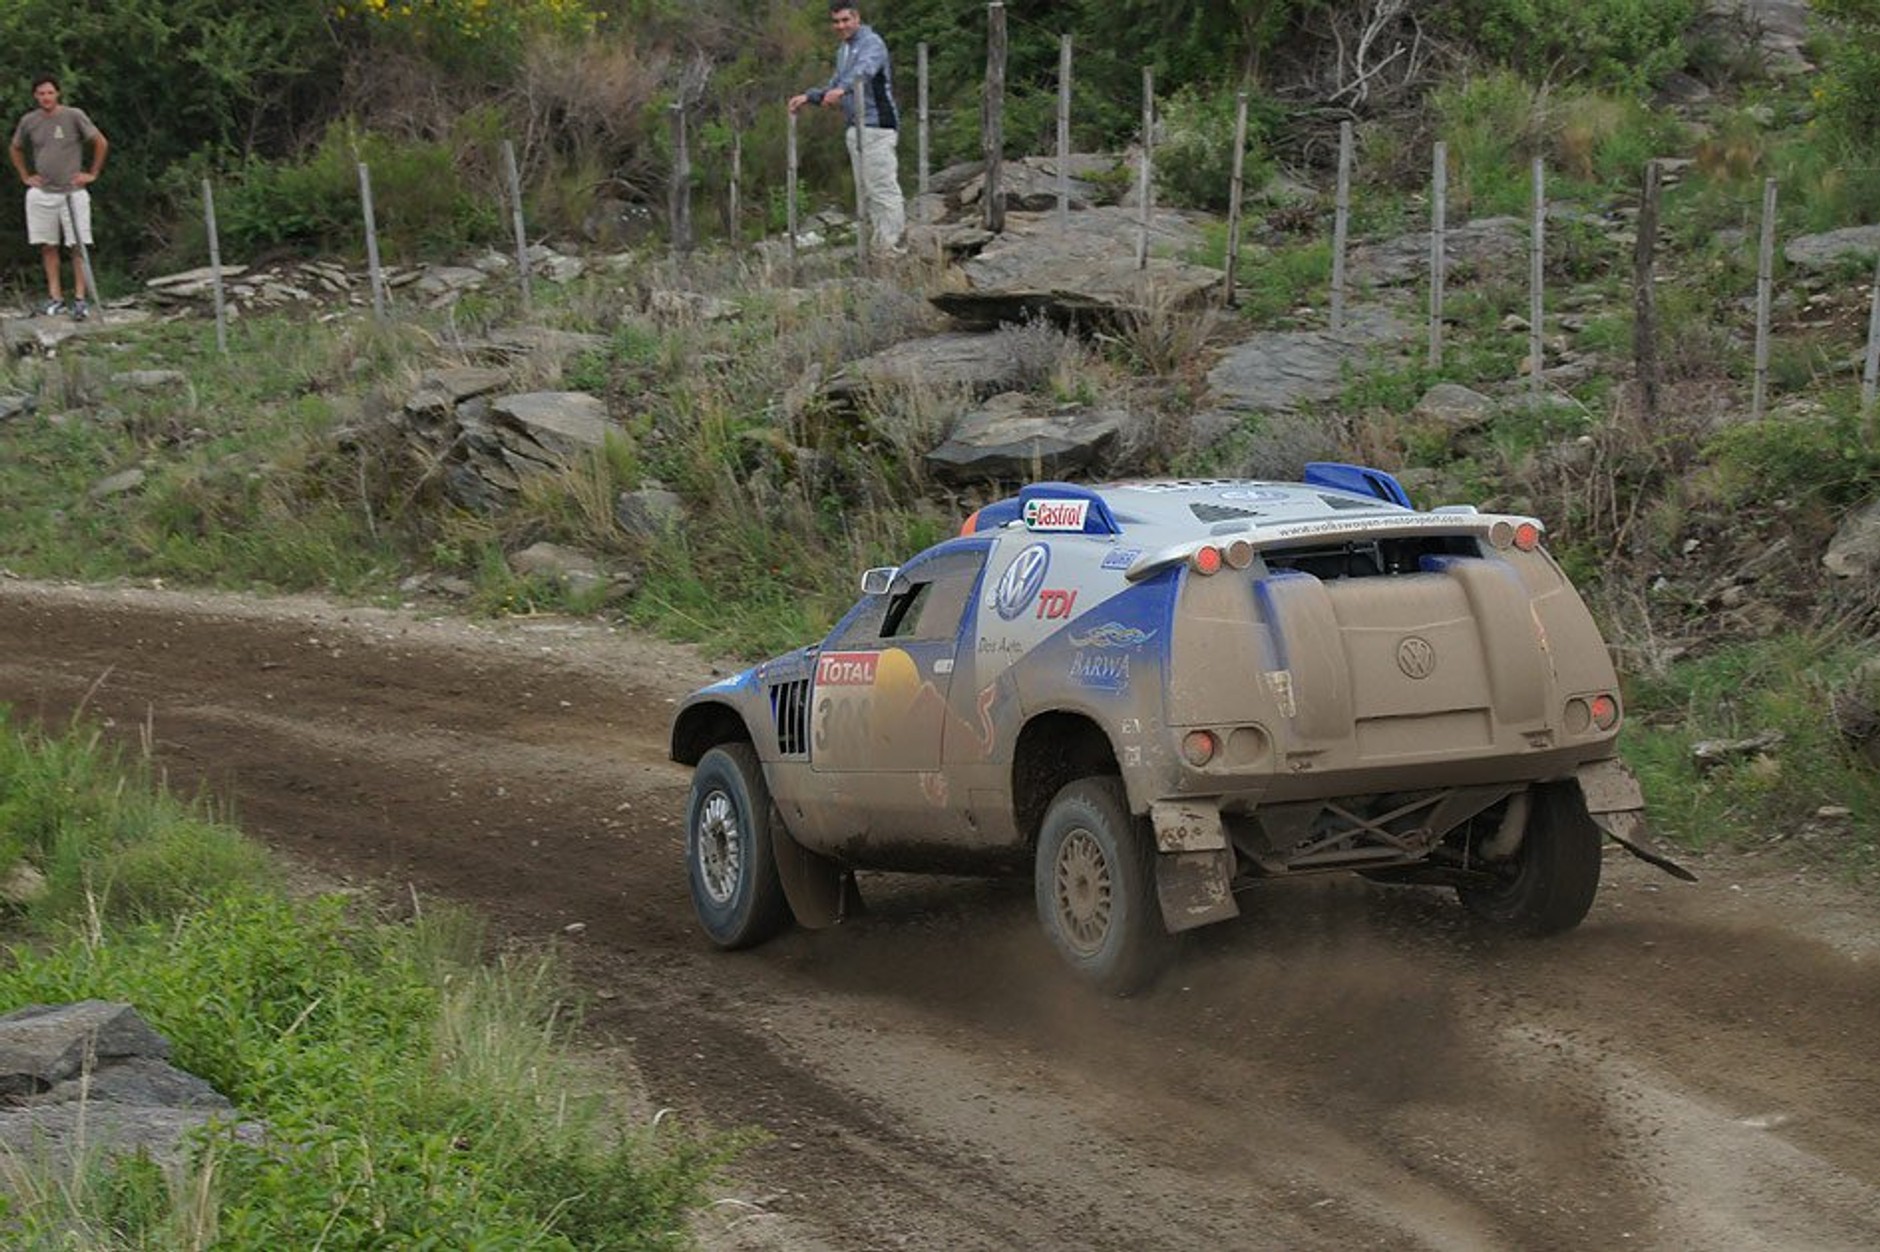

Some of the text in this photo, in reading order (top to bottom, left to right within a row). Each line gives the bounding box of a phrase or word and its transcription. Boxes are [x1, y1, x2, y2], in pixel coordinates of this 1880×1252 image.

[1037, 503, 1084, 527] Castrol
[1035, 588, 1078, 621] TDI
[1069, 650, 1130, 678] BARWA
